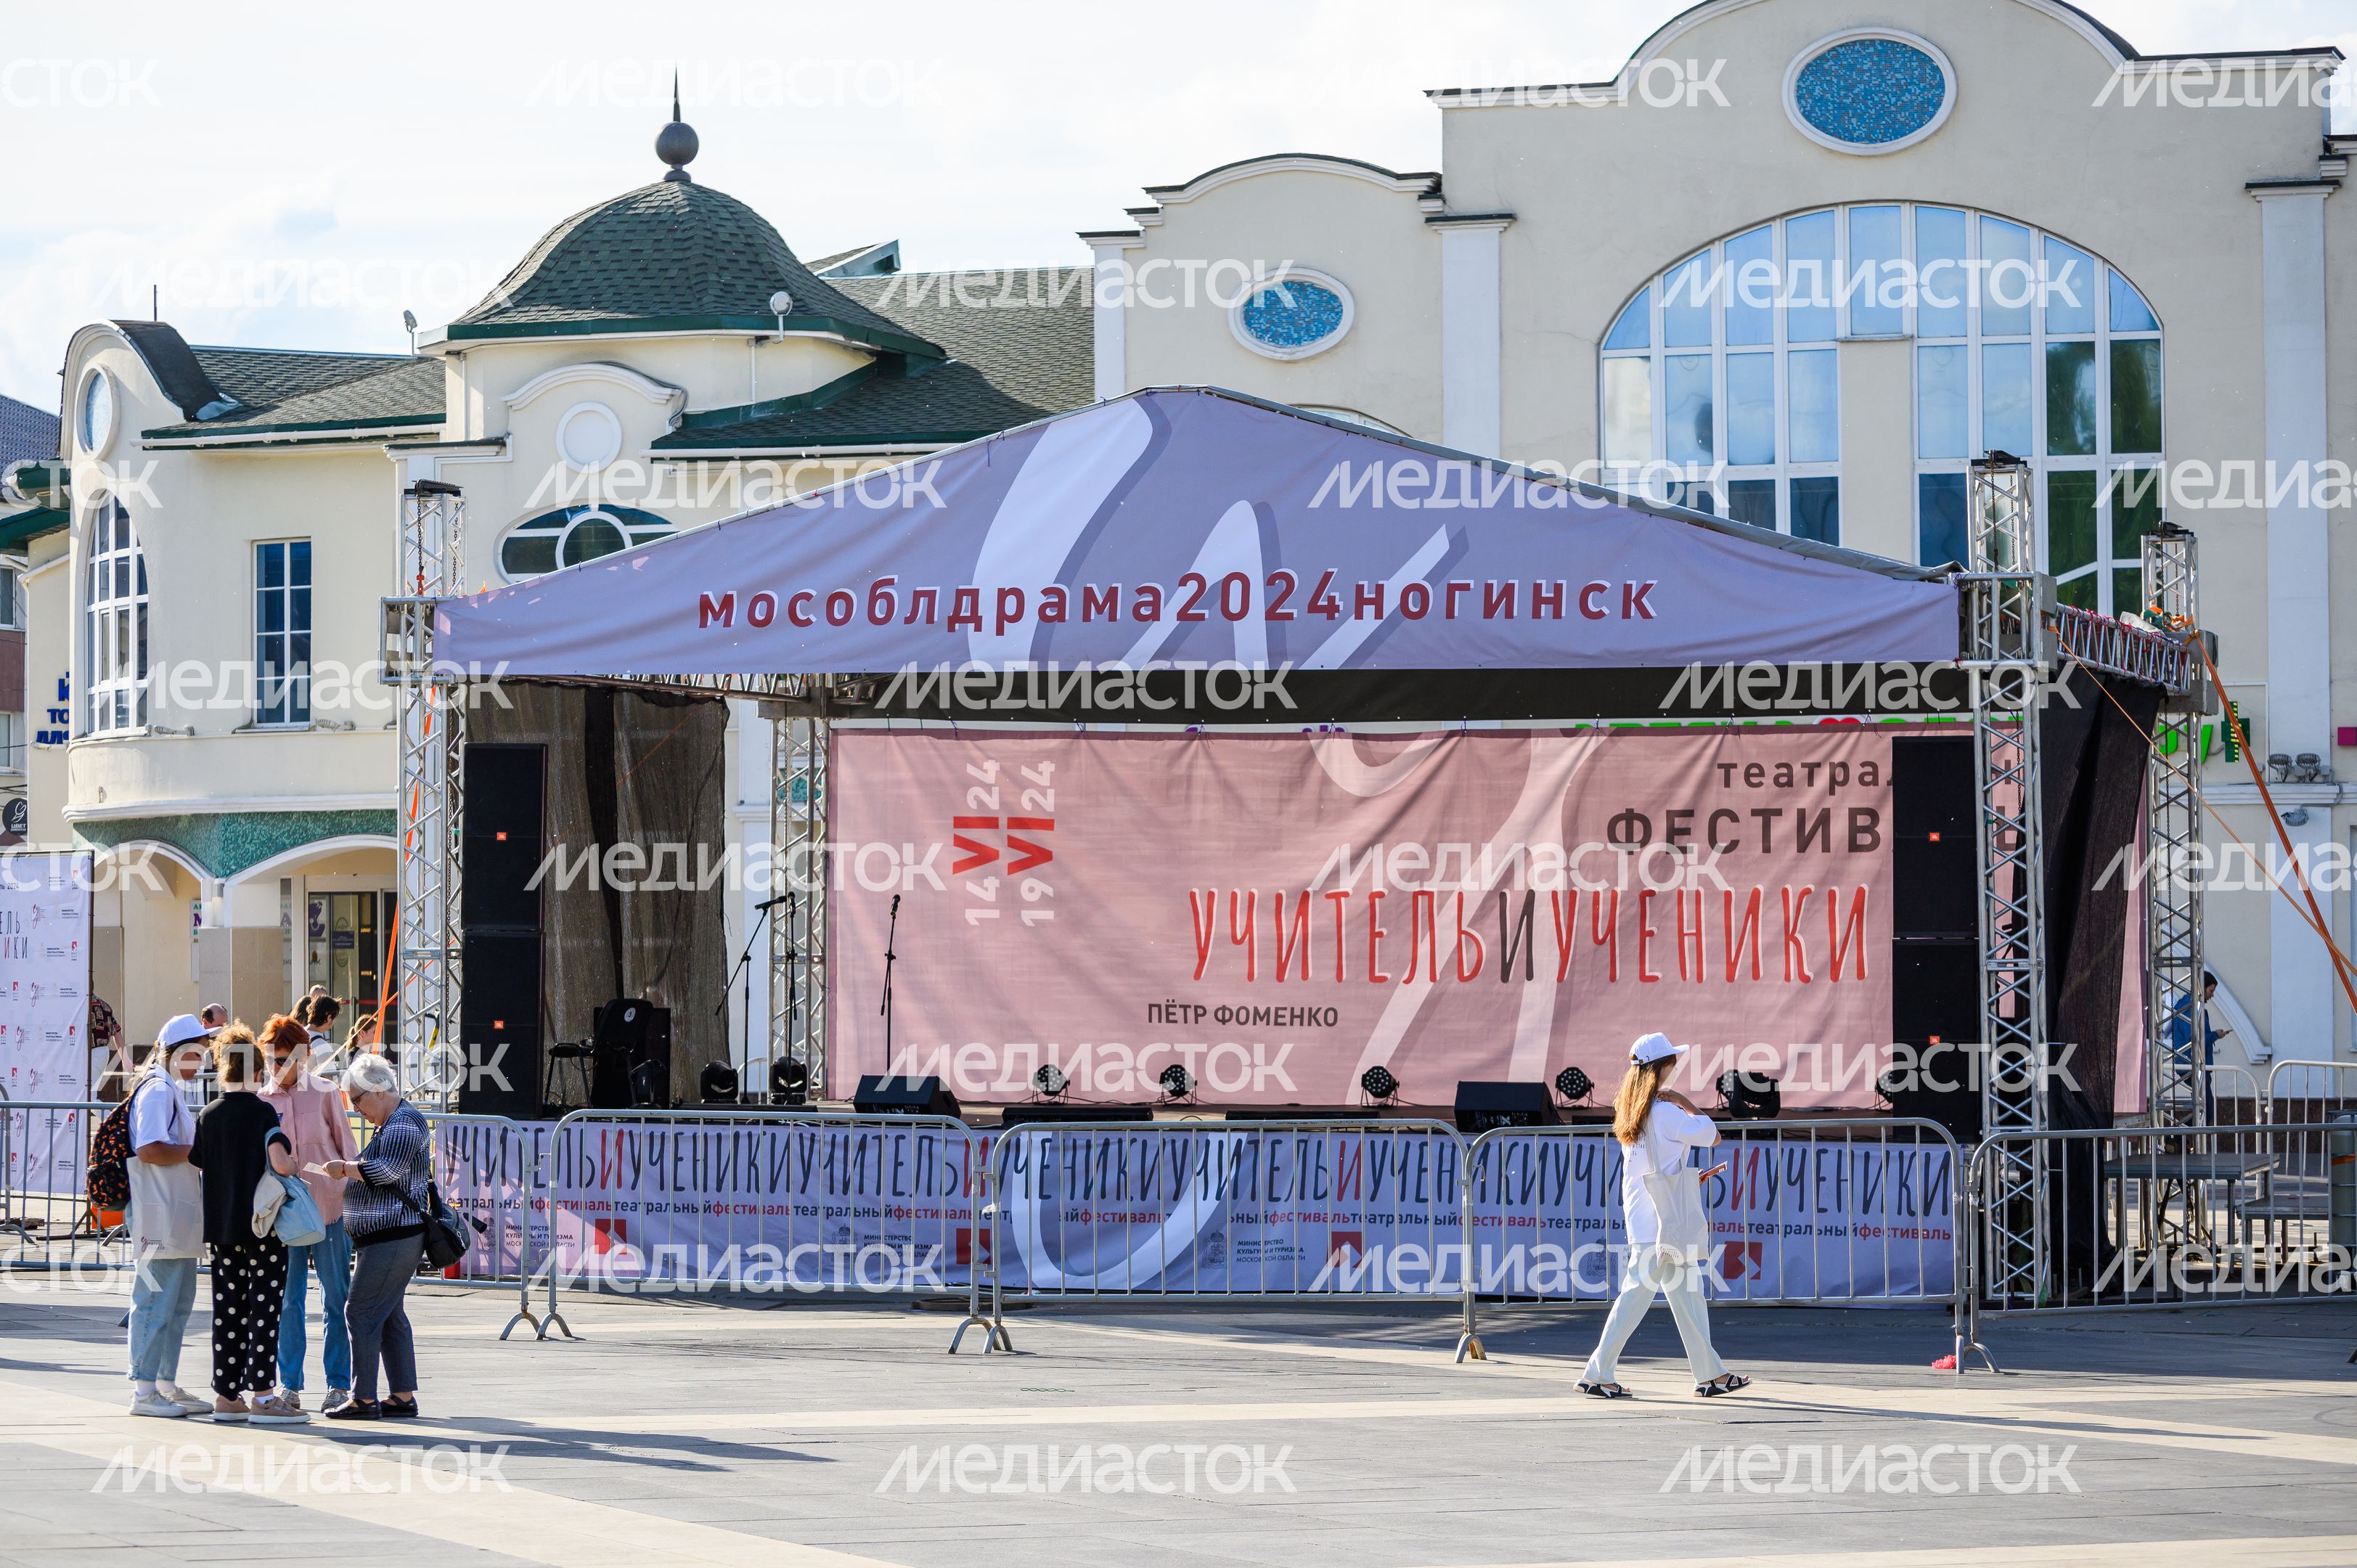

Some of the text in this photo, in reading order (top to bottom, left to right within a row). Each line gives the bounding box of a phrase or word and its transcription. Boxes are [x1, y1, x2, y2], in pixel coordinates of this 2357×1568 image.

[966, 759, 1000, 810] 24
[1021, 761, 1055, 812] 24
[1717, 760, 1892, 796] театра
[1606, 807, 1882, 854] ФЕСТИВ
[1148, 999, 1339, 1028] ПЁТР ФОМЕНКО
